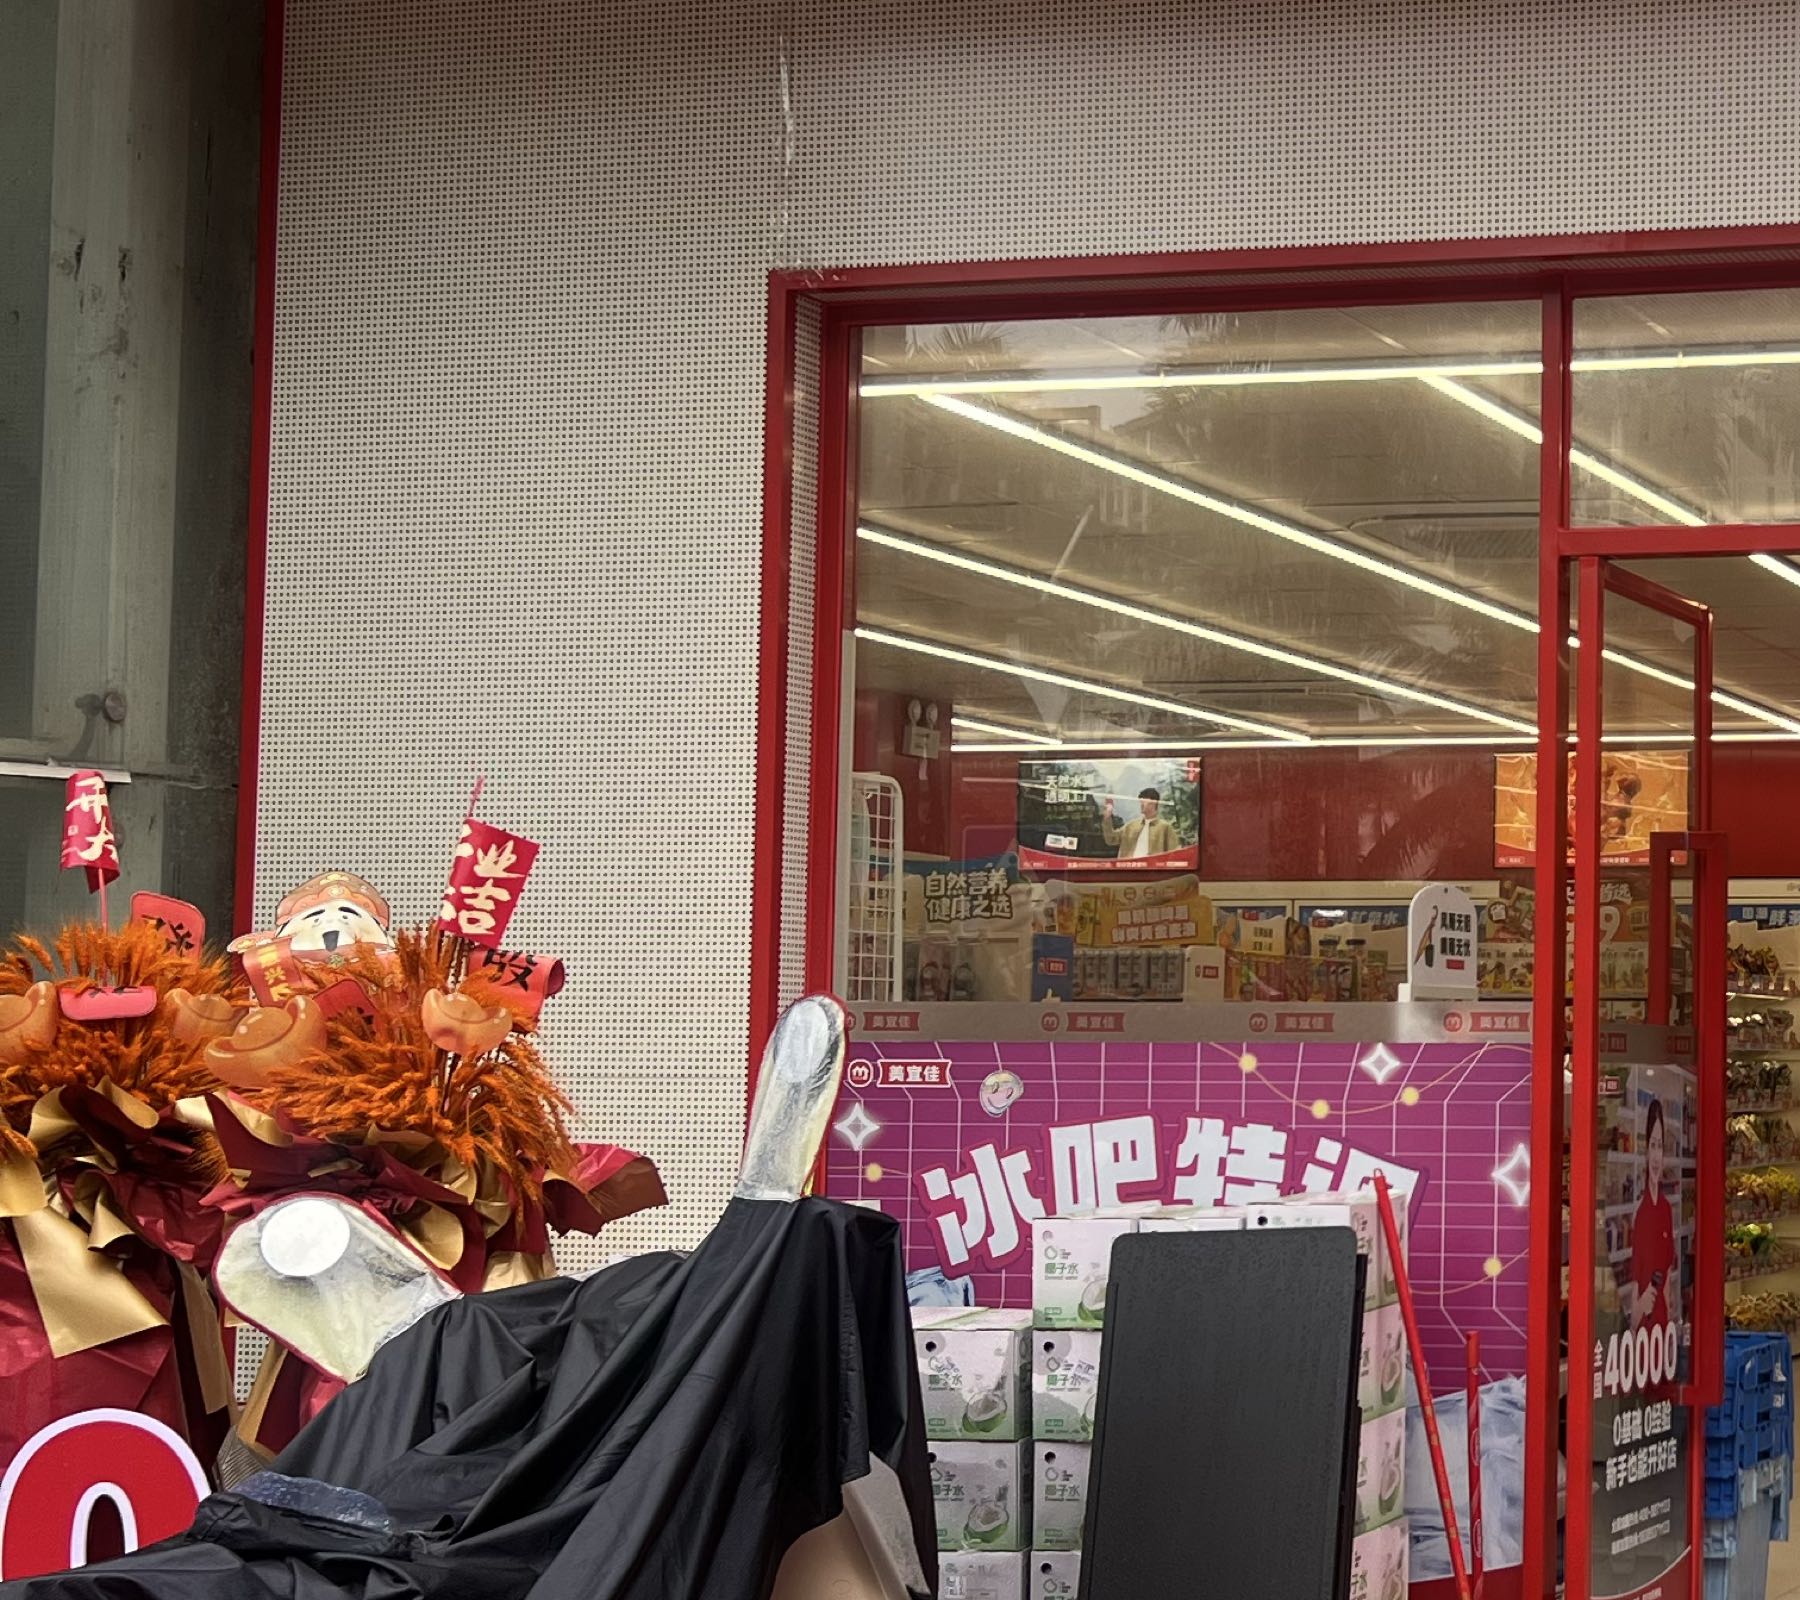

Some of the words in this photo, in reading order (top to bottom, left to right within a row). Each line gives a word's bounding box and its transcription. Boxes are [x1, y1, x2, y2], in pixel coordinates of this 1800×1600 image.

[925, 868, 1007, 896] 自然营养
[926, 898, 1012, 921] 健康之选
[872, 1015, 912, 1029] 美宜佳
[1076, 1015, 1115, 1030] 美宜佳
[1284, 1016, 1324, 1030] 美宜佳
[1479, 1016, 1520, 1030] 美宜佳
[888, 1064, 940, 1083] 美宜佳
[1604, 1321, 1678, 1397] 40000
[1605, 1437, 1678, 1492] 新手也能开好店
